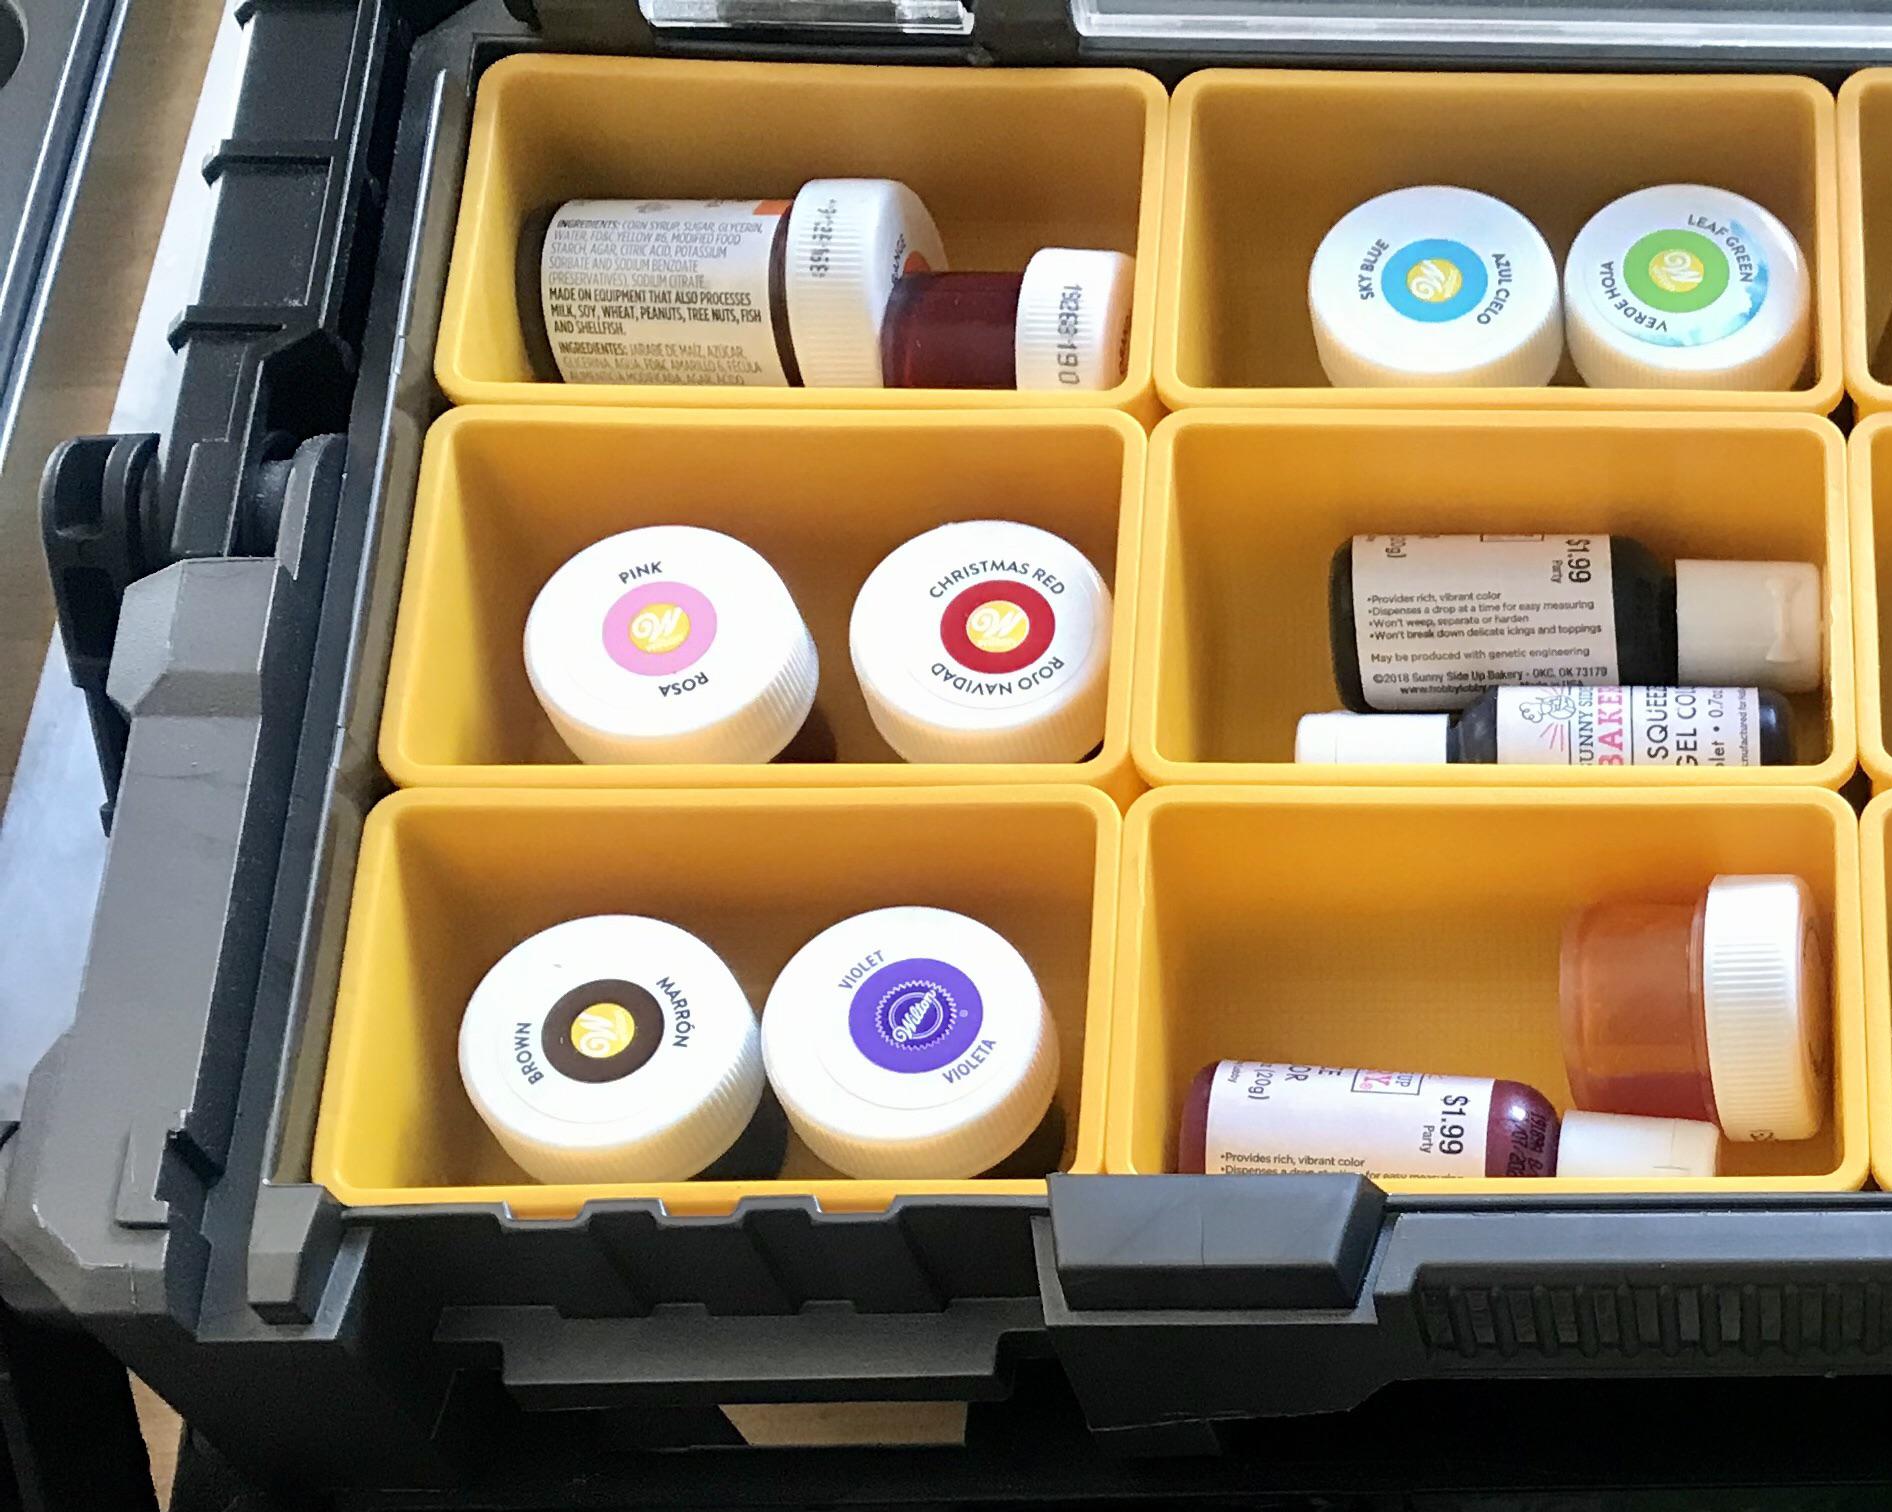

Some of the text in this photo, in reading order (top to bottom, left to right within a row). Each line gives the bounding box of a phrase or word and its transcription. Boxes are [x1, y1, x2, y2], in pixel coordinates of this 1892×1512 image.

[1687, 213, 1754, 283] LEAF GREEN
[1359, 238, 1390, 301] SKY BLUE
[549, 288, 752, 306] MADE ON EQUIPMENT THAT ALSO PROCESSES
[1477, 253, 1513, 325] AZUL CIELO
[1599, 261, 1668, 333] VERDE HOJA
[554, 320, 575, 333] AND
[601, 305, 639, 321] WHEAT,
[640, 306, 686, 322] PEANUTS,
[687, 307, 711, 321] TREE
[741, 309, 762, 323] FISH
[617, 560, 664, 585] PINK
[1550, 559, 1564, 584] Party
[1565, 538, 1593, 584] $1.99
[928, 559, 1065, 599] CHRISTMAS RED
[1432, 603, 1457, 617] drop
[1478, 602, 1501, 613] time
[1502, 601, 1517, 612] for
[1518, 603, 1541, 615] easy
[1543, 599, 1595, 613] measuring
[1438, 591, 1474, 602] vibrant
[1475, 590, 1502, 601] color
[1406, 628, 1436, 640] break
[1437, 627, 1465, 639] down
[1466, 625, 1507, 638] delicate
[1537, 624, 1557, 635] and
[1557, 623, 1603, 638] toppings
[1494, 613, 1530, 625] harden
[1371, 646, 1591, 665] May be produced with genetic engineering
[657, 671, 710, 698] ROSA
[929, 655, 1065, 697] ROJO NAVIDAD
[1411, 670, 1444, 684] Sunny
[1445, 669, 1470, 683] Side
[1471, 669, 1486, 683] Up
[1486, 668, 1524, 682] Bakery
[1558, 666, 1574, 678] OK
[838, 949, 885, 992] VIOLET
[655, 976, 695, 1049] MARRÓN
[892, 987, 938, 1044] Wilton
[515, 1021, 544, 1086] BROWN
[941, 1037, 997, 1086] VIOLETA
[1419, 1125, 1436, 1154] Party
[1439, 1095, 1471, 1156] $1.99
[1273, 1154, 1296, 1166] rich,
[1298, 1155, 1335, 1167] vibrant
[1337, 1156, 1366, 1168] color
